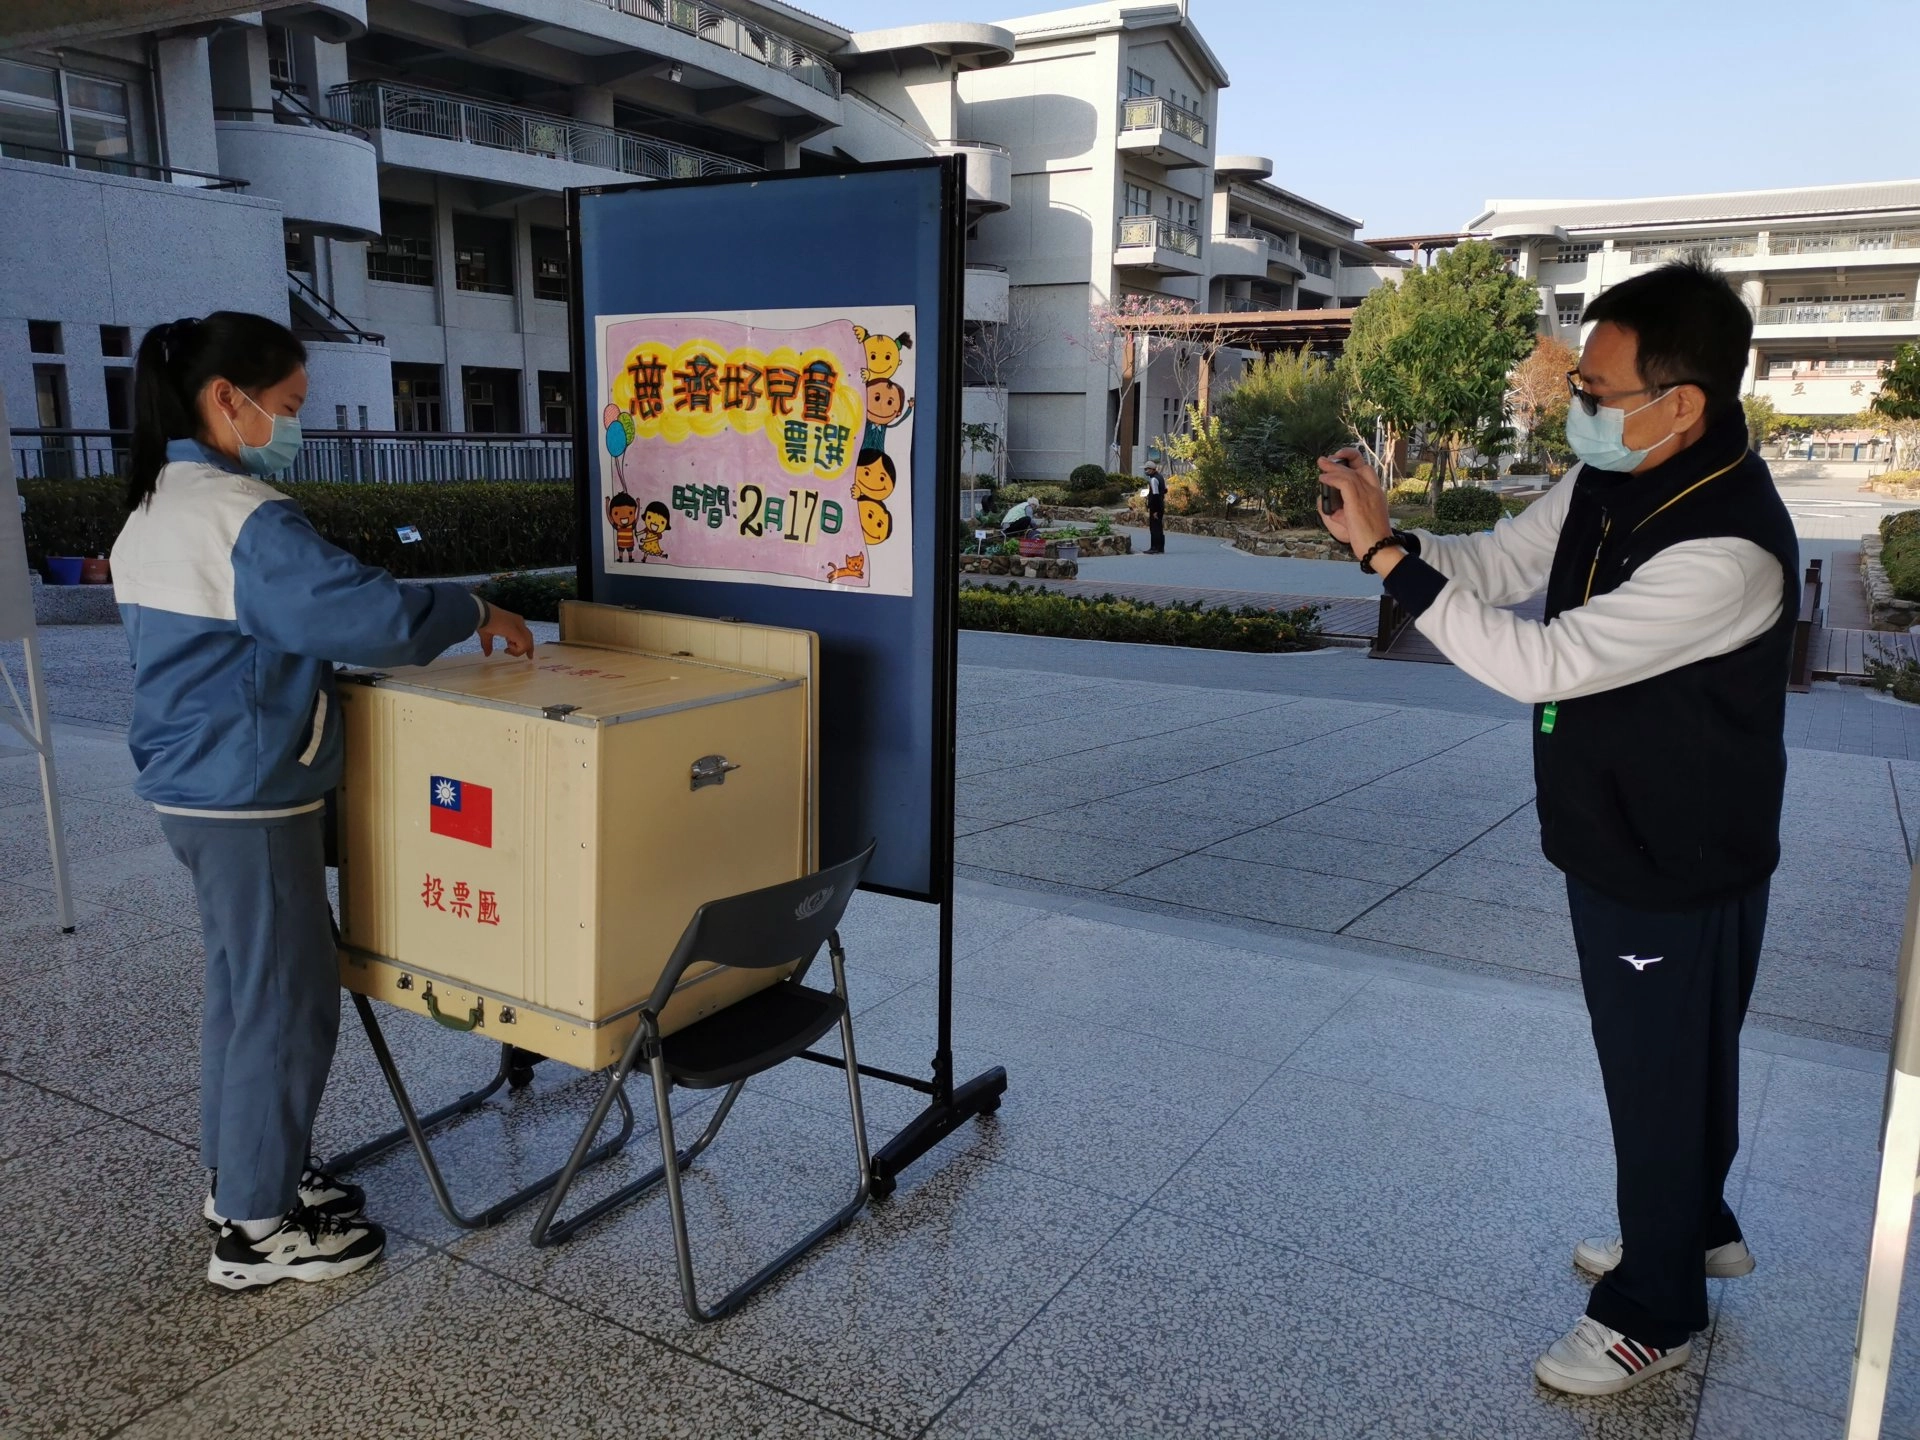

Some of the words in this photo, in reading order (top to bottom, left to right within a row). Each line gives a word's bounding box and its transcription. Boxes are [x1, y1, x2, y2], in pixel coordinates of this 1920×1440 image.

[628, 354, 837, 424] 慈濟好兒童
[784, 419, 850, 469] 票選
[421, 873, 500, 926] 投票匭
